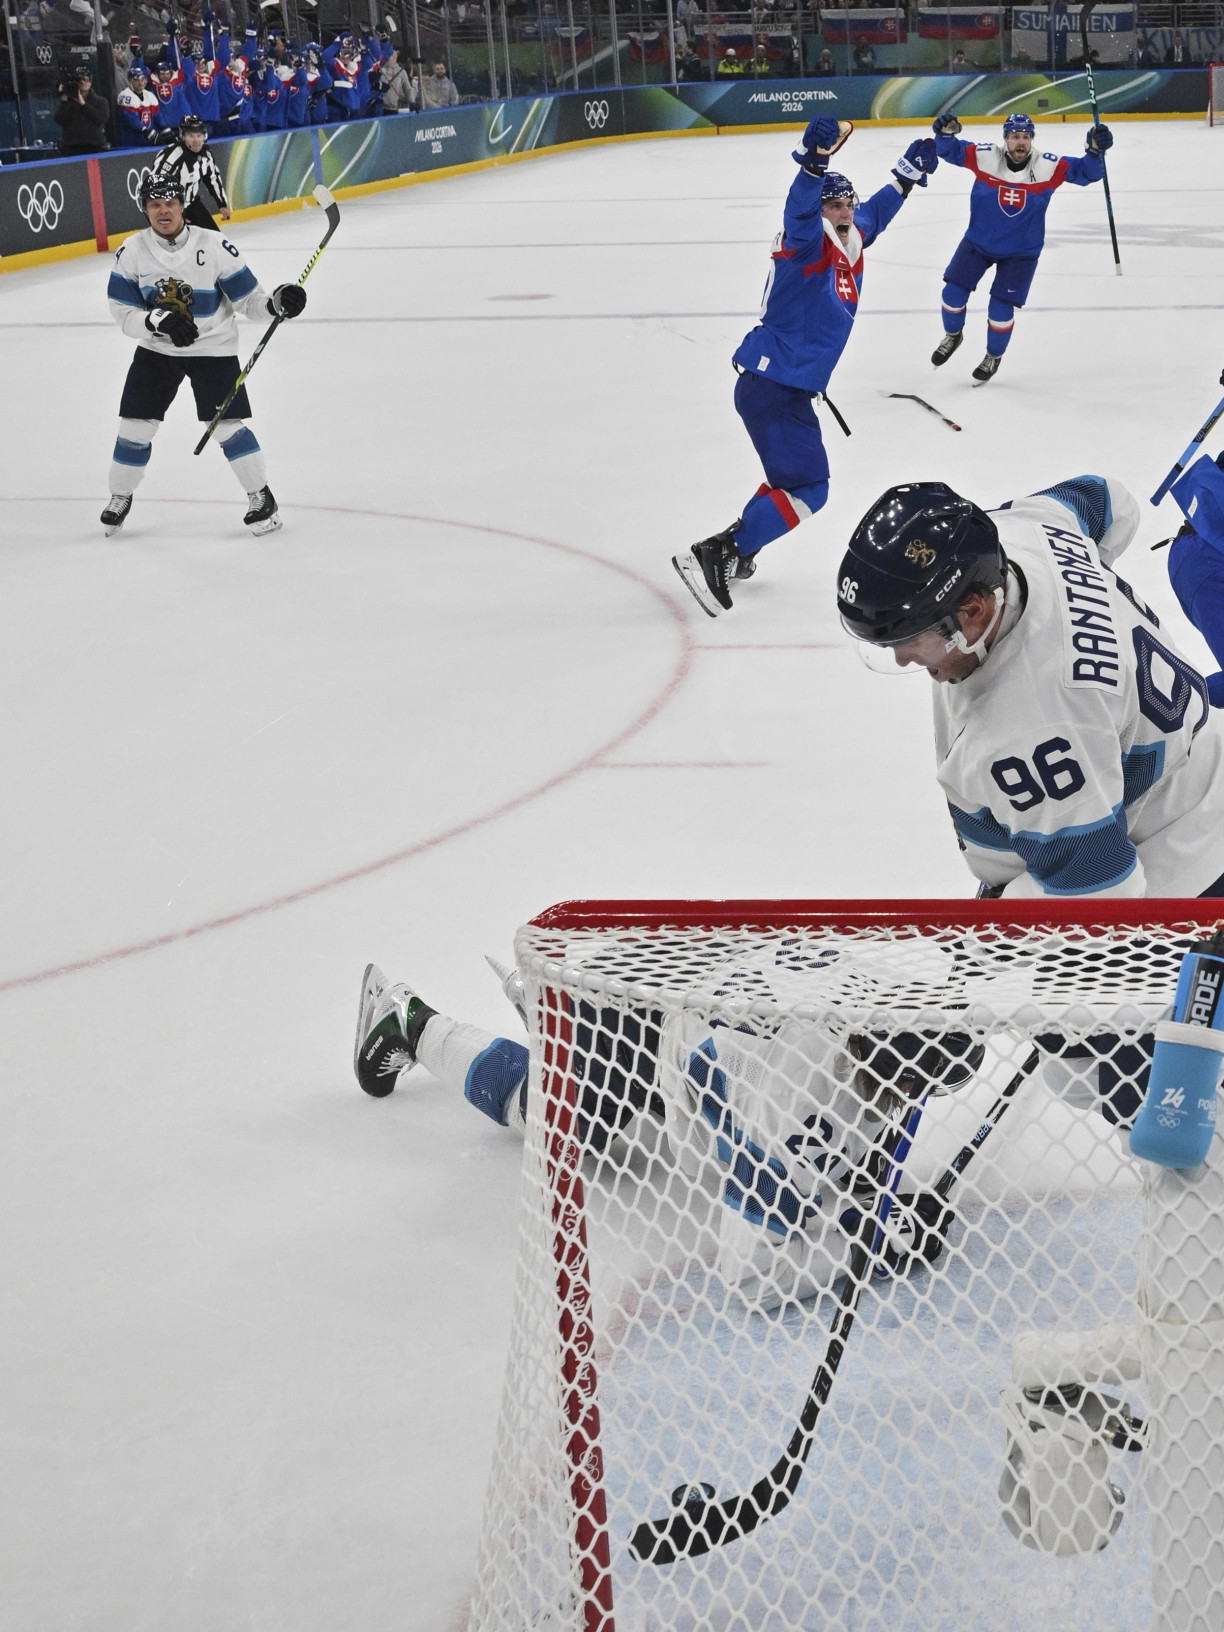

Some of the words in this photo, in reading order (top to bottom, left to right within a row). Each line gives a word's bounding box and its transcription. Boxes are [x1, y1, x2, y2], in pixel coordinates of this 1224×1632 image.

[120, 94, 132, 104] 79
[748, 92, 790, 103] MILANO
[792, 90, 838, 100] CORTINA
[782, 102, 803, 112] 2026
[1029, 168, 1036, 183] A
[196, 250, 206, 266] C
[838, 575, 859, 604] 96
[935, 568, 963, 603] CCM
[1041, 523, 1119, 687] RANTANEN
[990, 736, 1086, 812] 96
